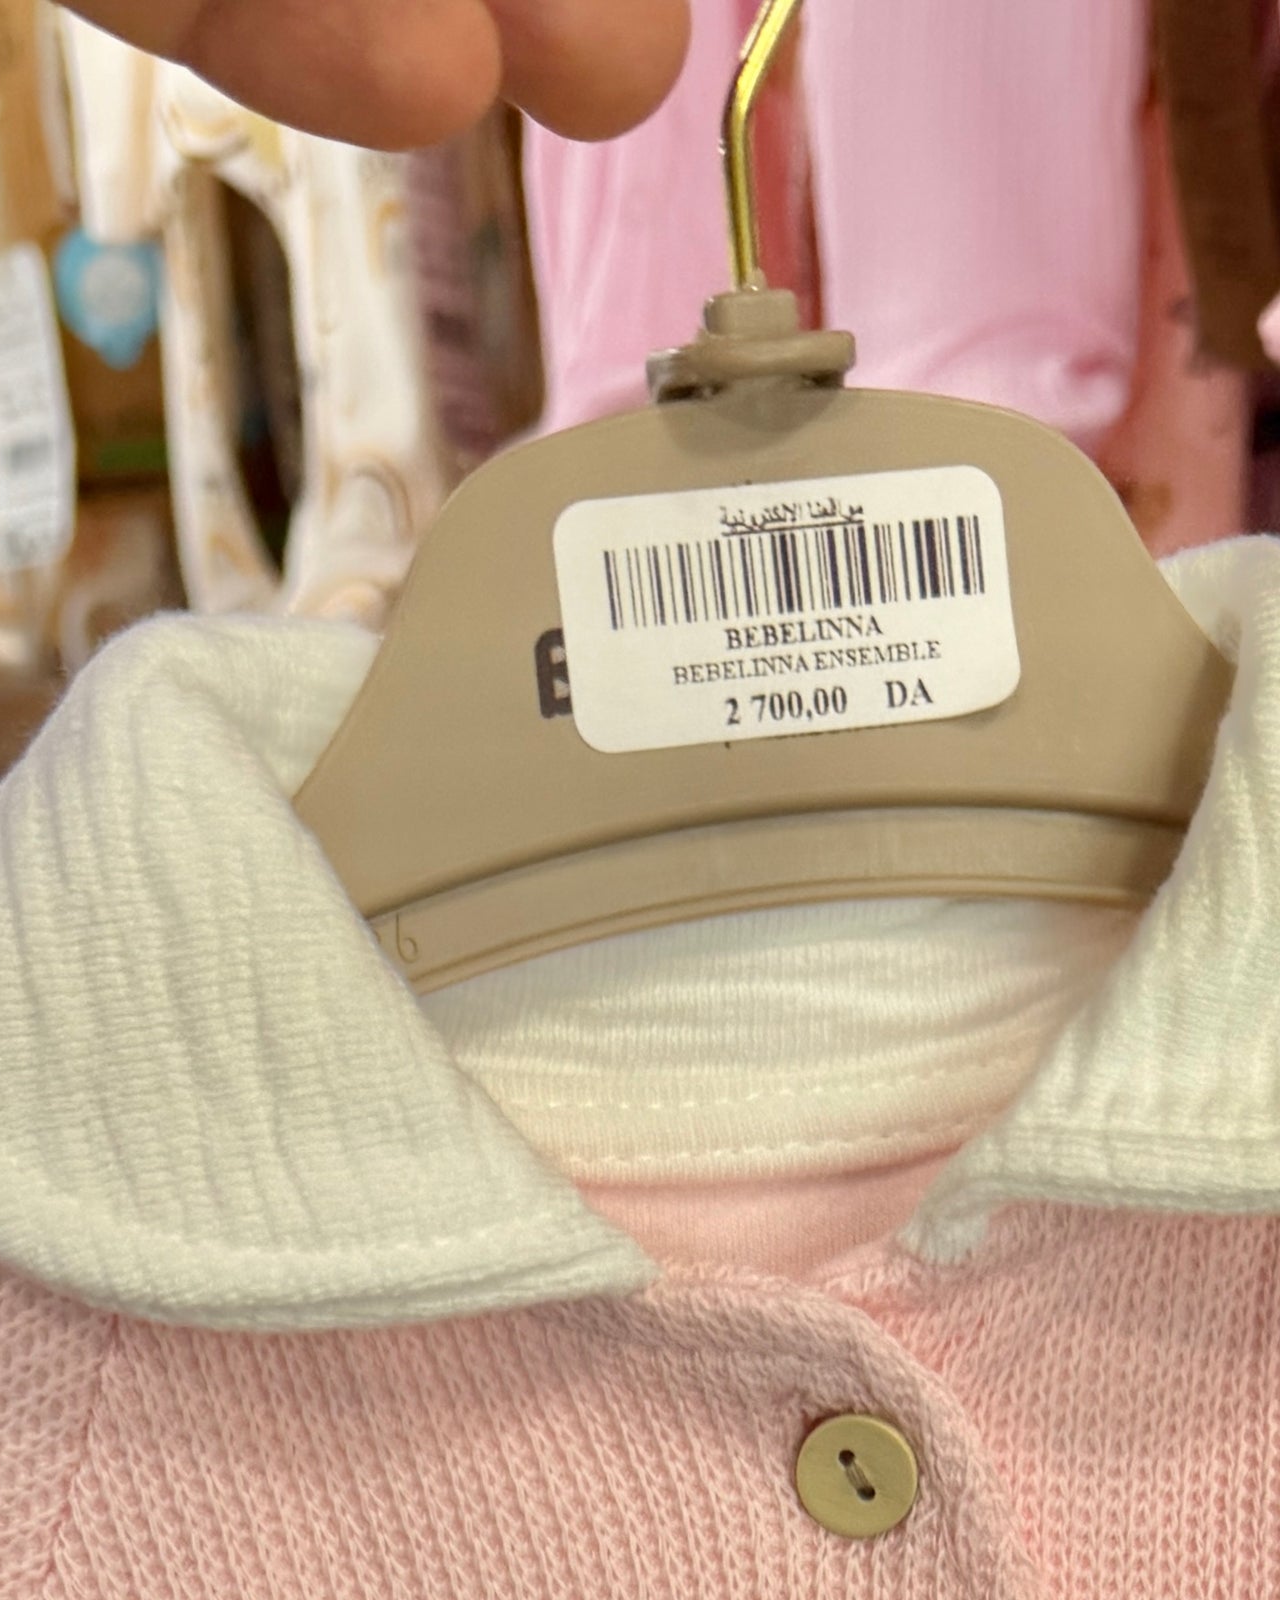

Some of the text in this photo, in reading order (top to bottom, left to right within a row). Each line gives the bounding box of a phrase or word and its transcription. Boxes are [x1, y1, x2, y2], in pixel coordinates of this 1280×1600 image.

[724, 614, 884, 650] BEBELINNA
[672, 640, 942, 685] BEBELINNA ENSEMBLE
[885, 677, 934, 709] DA
